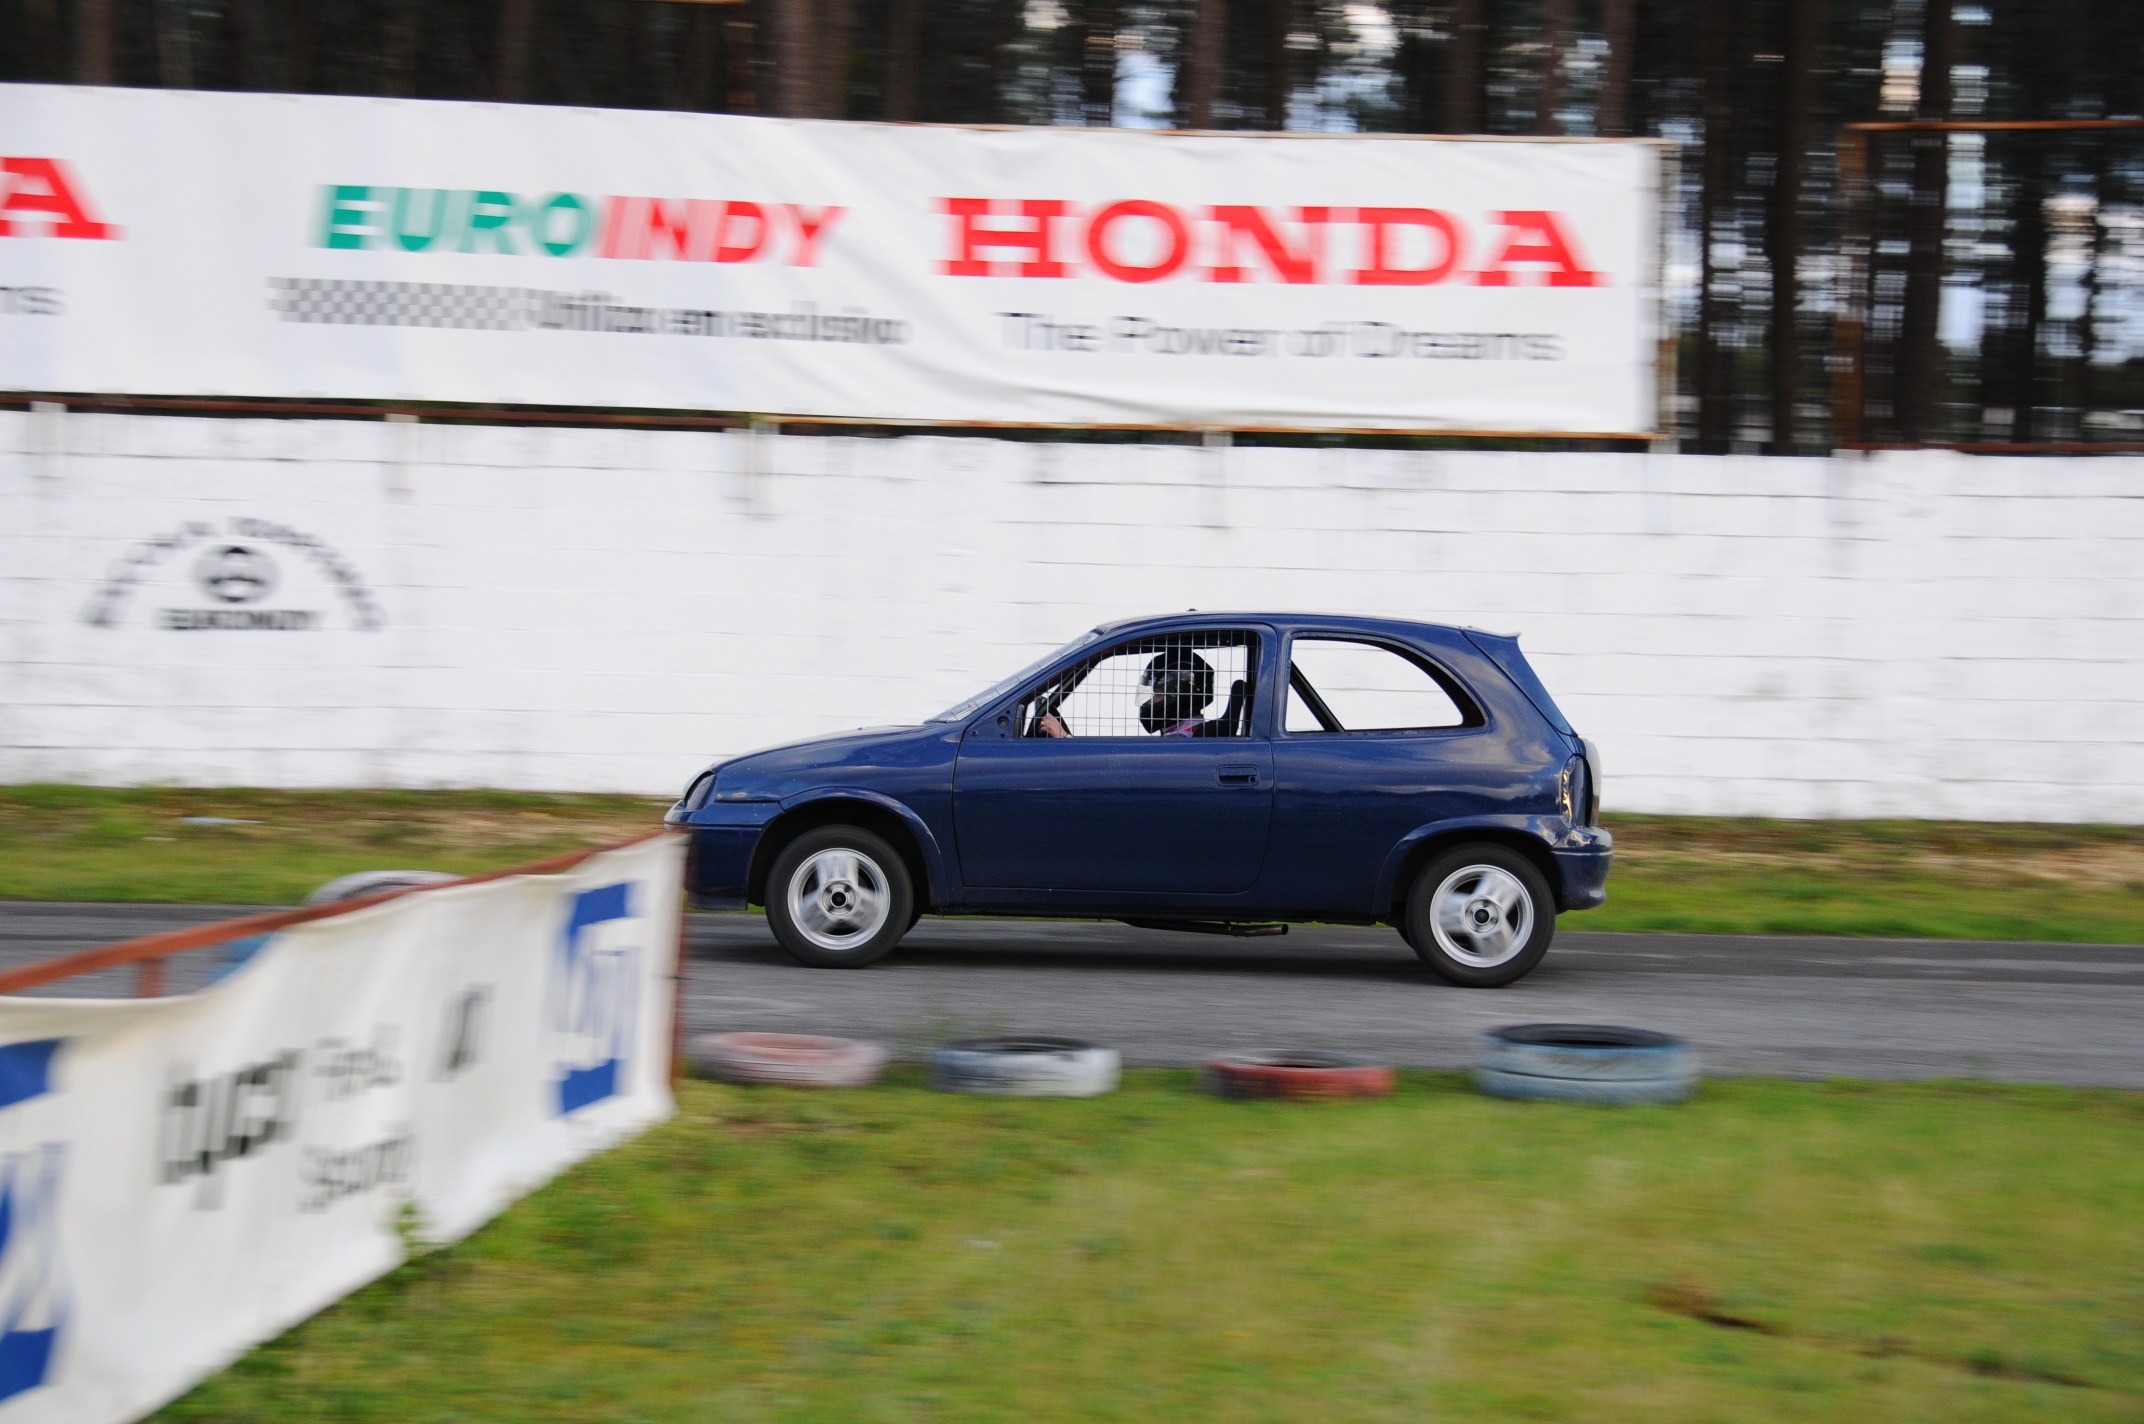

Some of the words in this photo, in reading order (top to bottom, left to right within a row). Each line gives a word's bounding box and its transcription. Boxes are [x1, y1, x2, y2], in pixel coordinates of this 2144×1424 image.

[318, 184, 849, 266] EUROINDY
[935, 197, 1608, 286] HONDA
[995, 311, 1099, 352] The
[1108, 315, 1283, 357] Power
[1351, 321, 1566, 361] Dreams
